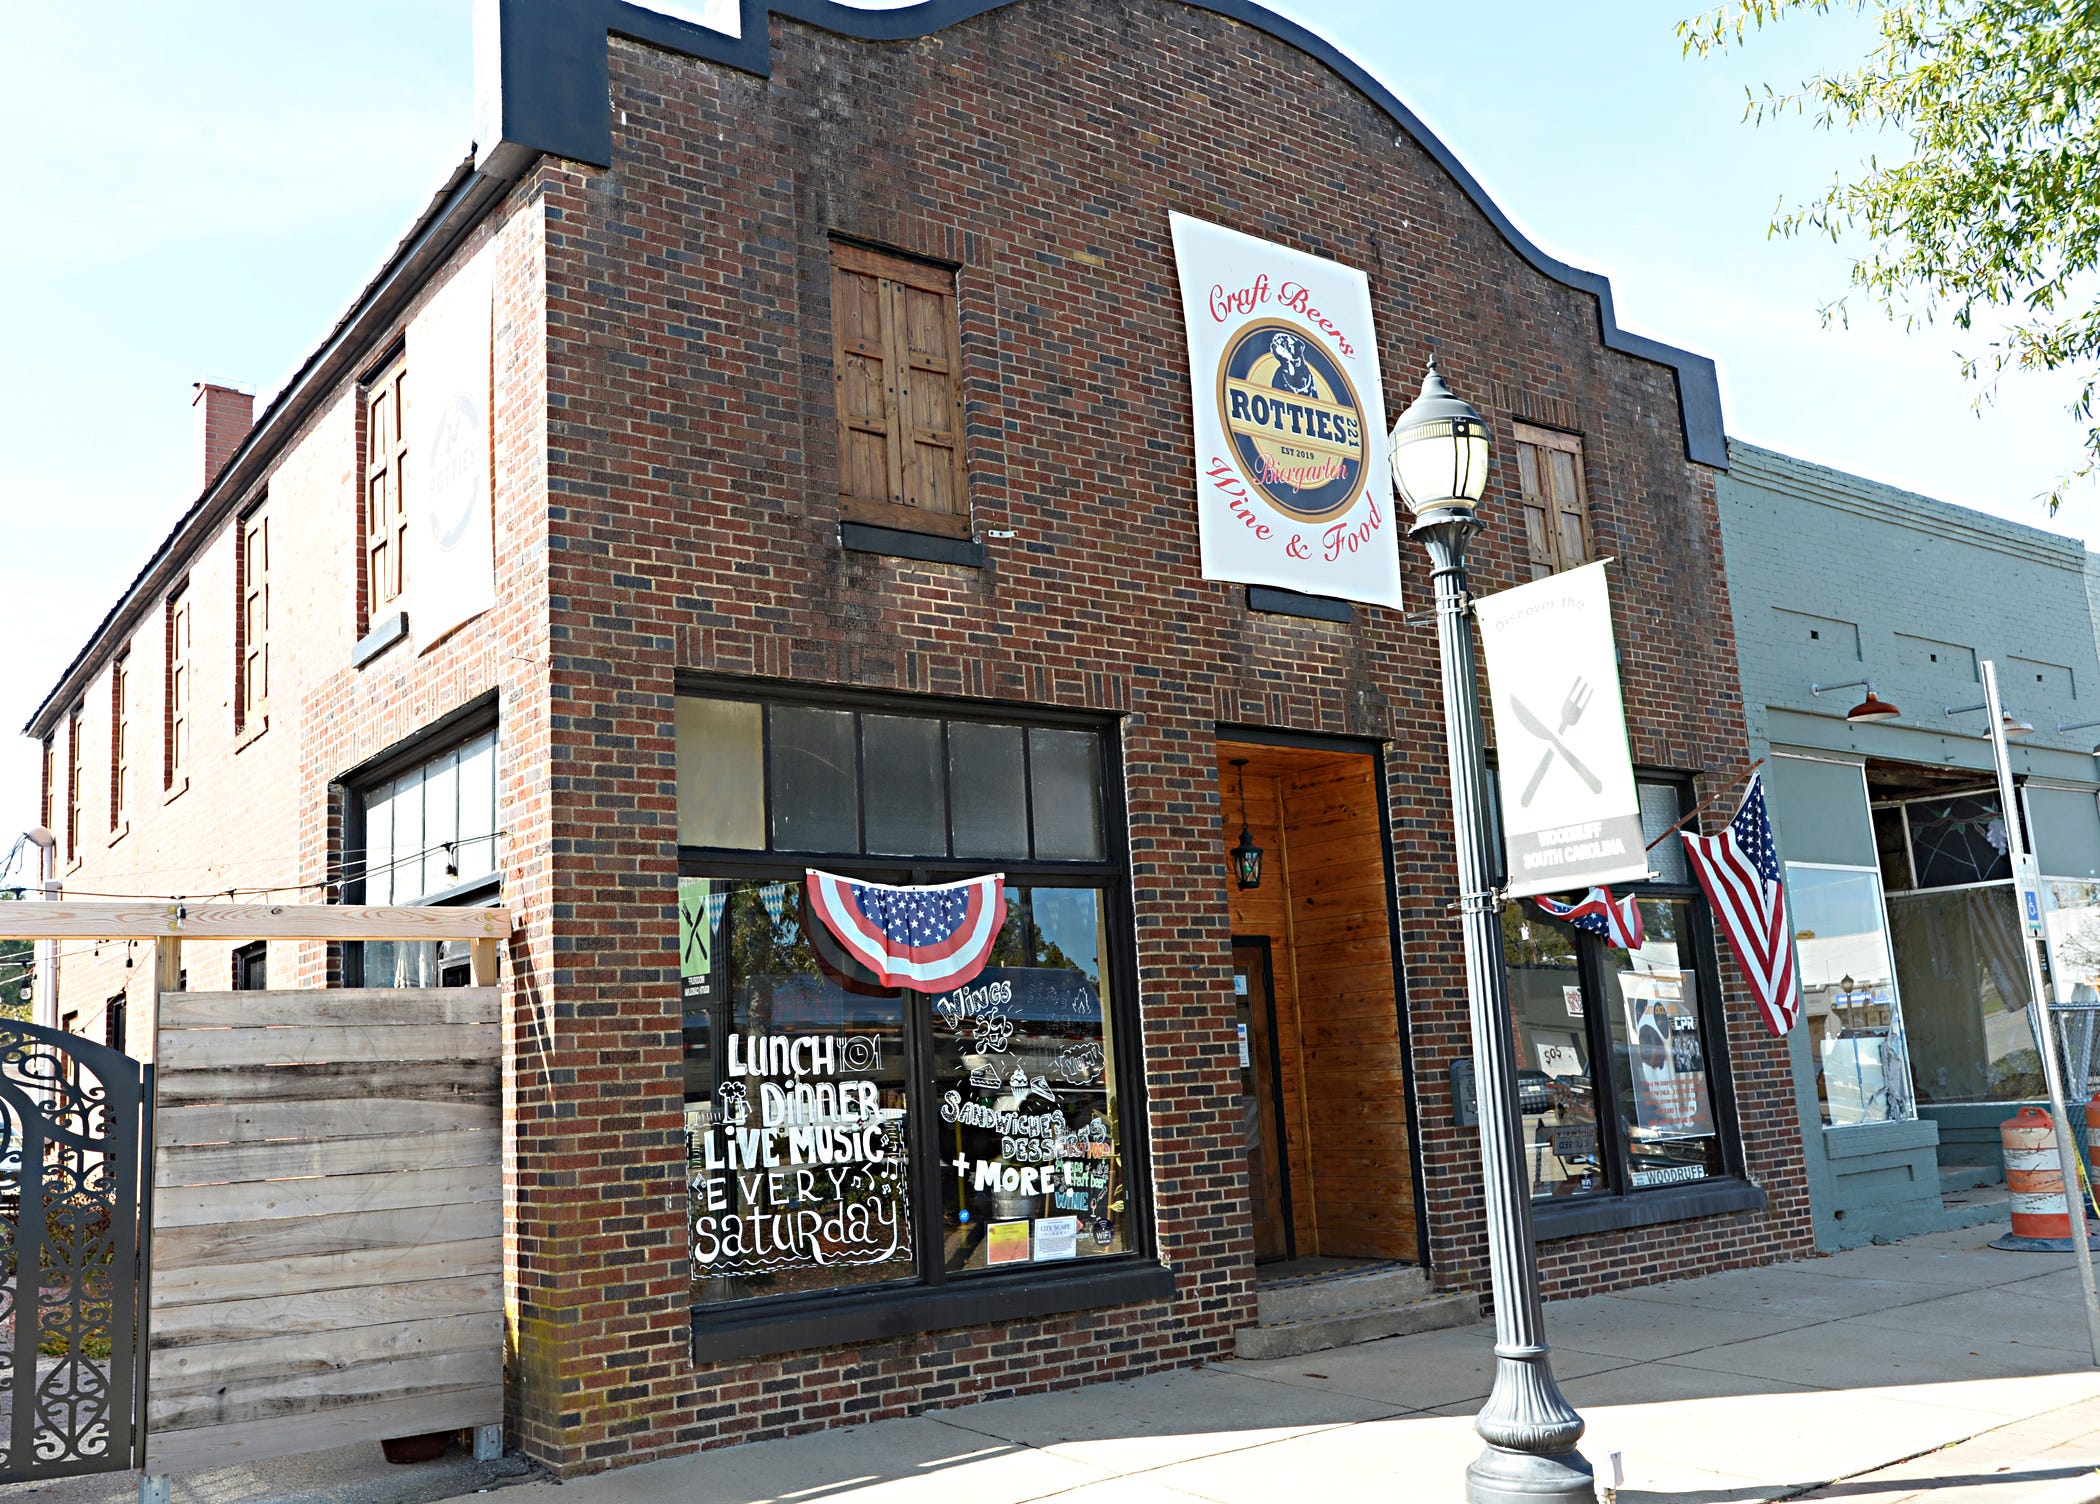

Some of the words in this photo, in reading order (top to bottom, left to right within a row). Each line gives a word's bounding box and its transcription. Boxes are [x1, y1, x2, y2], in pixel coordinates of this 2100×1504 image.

[1209, 274, 1272, 322] Craft
[1278, 282, 1356, 359] Beers
[1230, 388, 1346, 444] ROTTIES
[1347, 417, 1359, 447] 221
[1281, 447, 1295, 455] EST
[1296, 451, 1314, 460] 2019
[1254, 453, 1348, 494] Biergarten
[1206, 457, 1273, 540] Wine
[1286, 534, 1312, 560] &
[1323, 490, 1382, 562] Food
[1561, 595, 1584, 610] the
[1538, 821, 1602, 848] WOODRUFF
[1523, 848, 1564, 870] SOUTH
[1564, 838, 1626, 863] CAROLINA
[1674, 1016, 1695, 1030] CPR
[1002, 1117, 1107, 1162] DESSERTS
[706, 1167, 852, 1211] EVERY
[1090, 1173, 1106, 1188] beer
[1647, 1166, 1702, 1184] WOODRUFF
